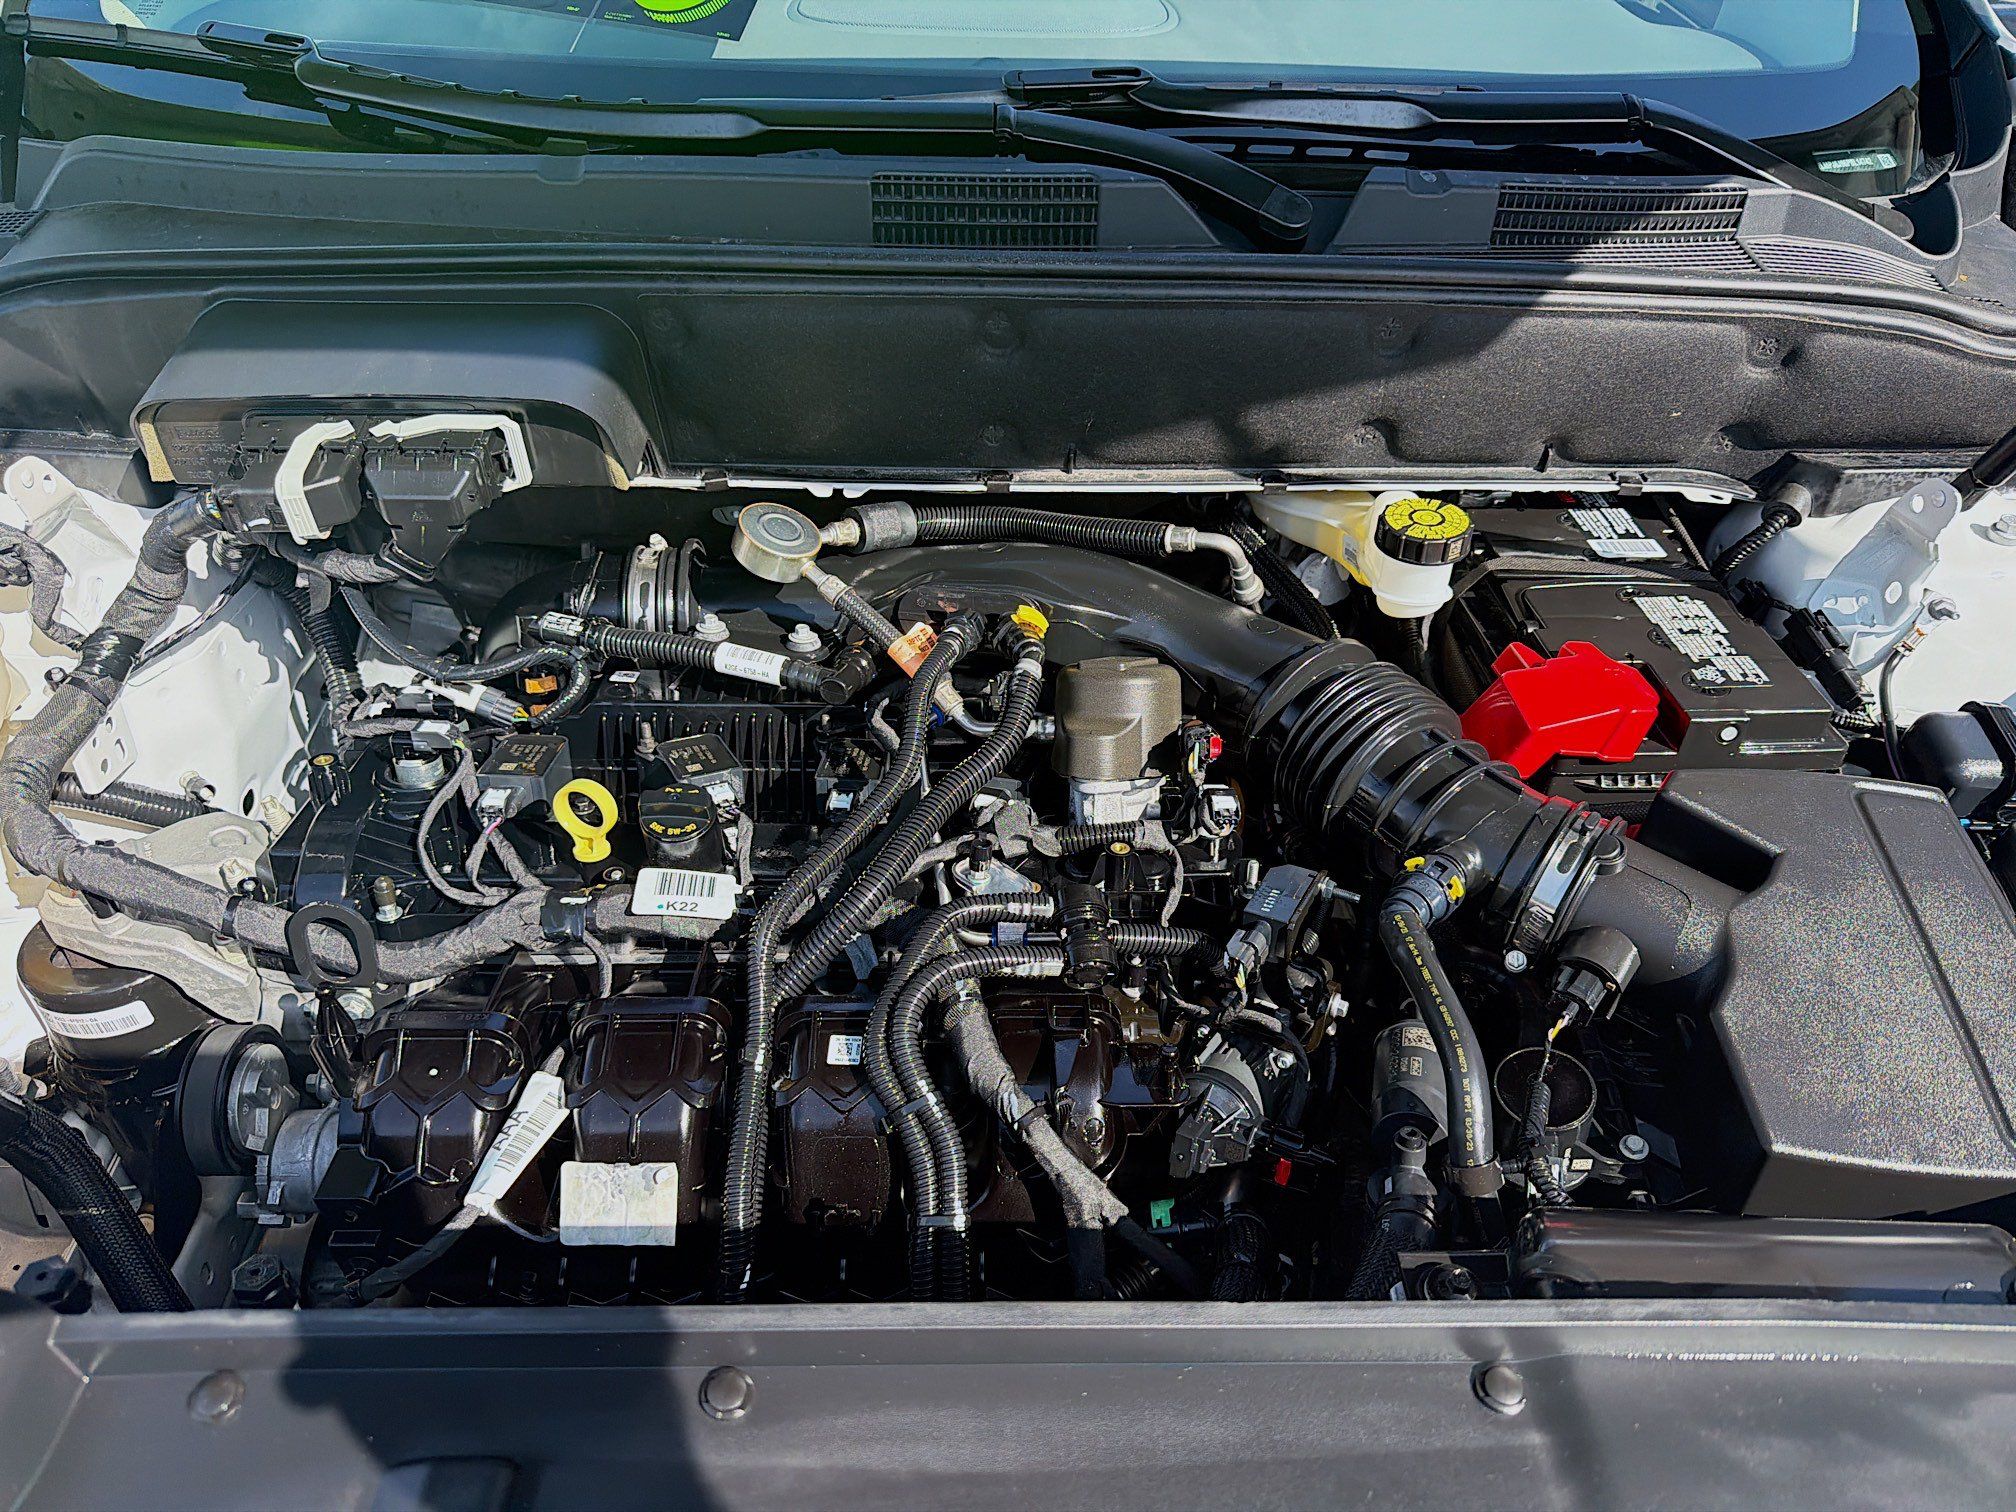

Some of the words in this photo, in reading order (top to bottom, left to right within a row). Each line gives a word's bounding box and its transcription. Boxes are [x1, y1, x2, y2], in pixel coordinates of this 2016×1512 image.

[650, 822, 665, 833] SAE
[667, 823, 697, 835] 5W-30
[666, 901, 699, 913] K22
